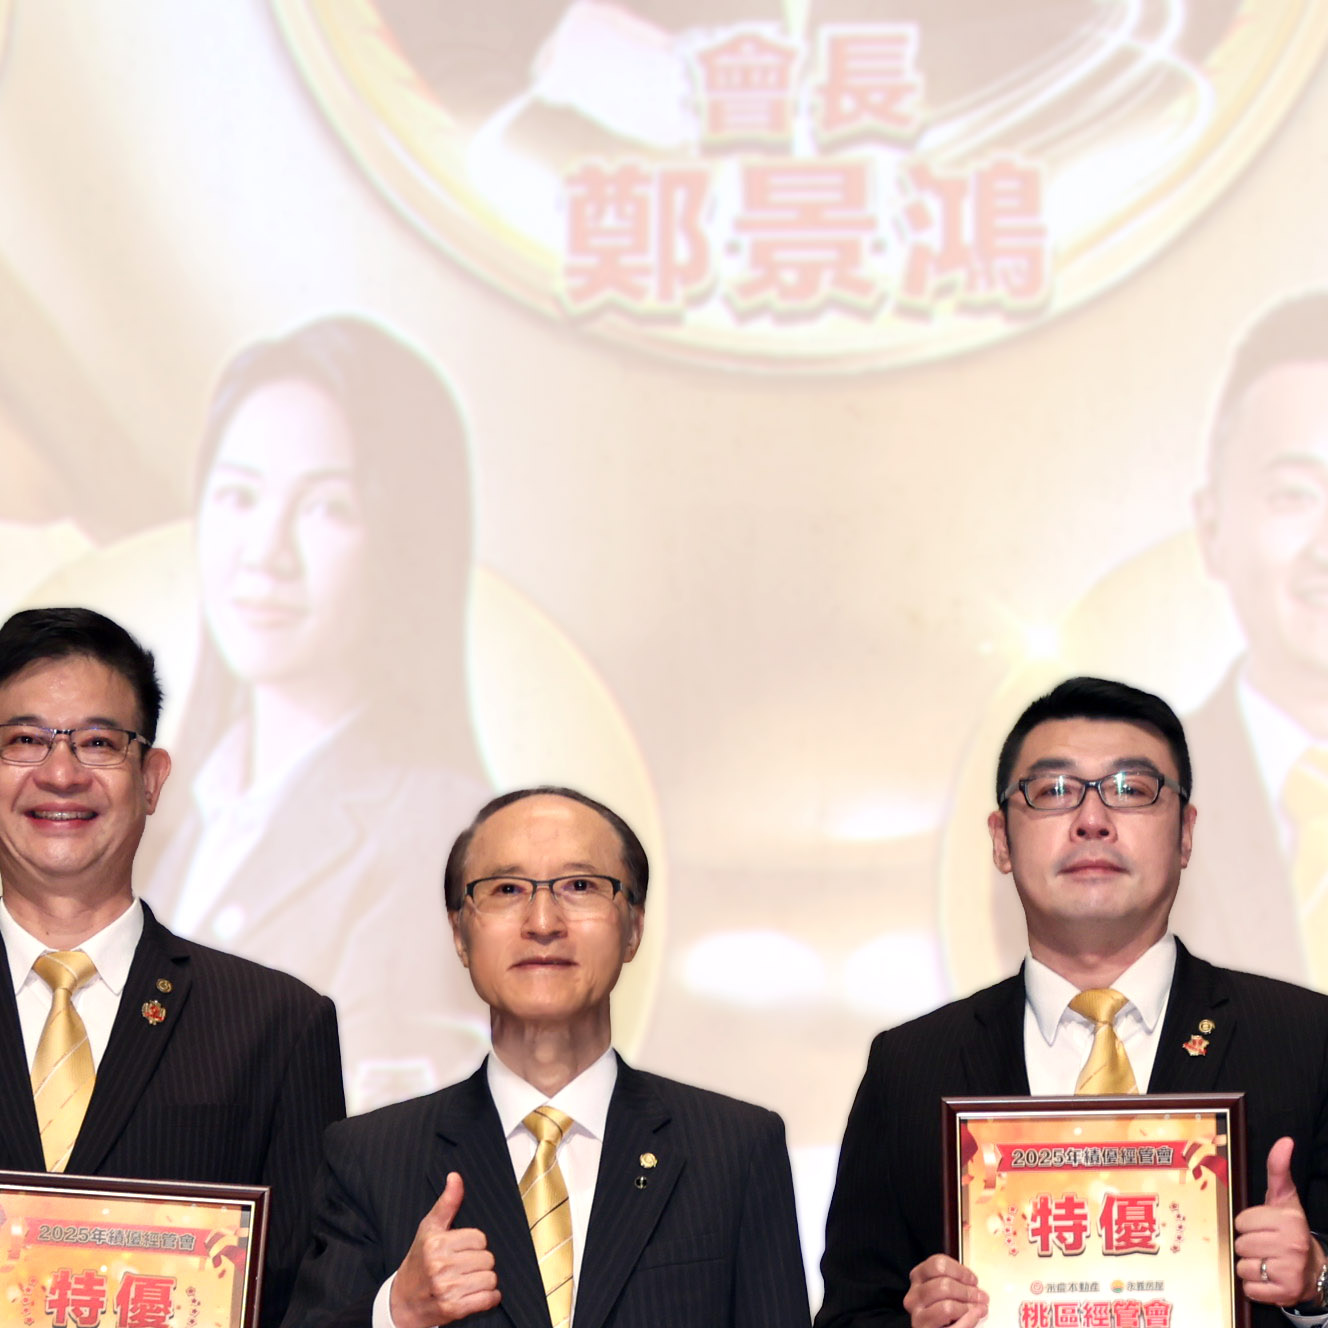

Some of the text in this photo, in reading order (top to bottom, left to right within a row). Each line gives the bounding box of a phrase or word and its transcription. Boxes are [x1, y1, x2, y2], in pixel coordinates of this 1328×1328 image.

[698, 30, 922, 146] 會長
[561, 157, 1050, 316] 鄭景鴻
[1012, 1147, 1174, 1167] 2025年績優經管會
[38, 1224, 196, 1251] 2025年績優經管會
[1029, 1192, 1160, 1257] 特優
